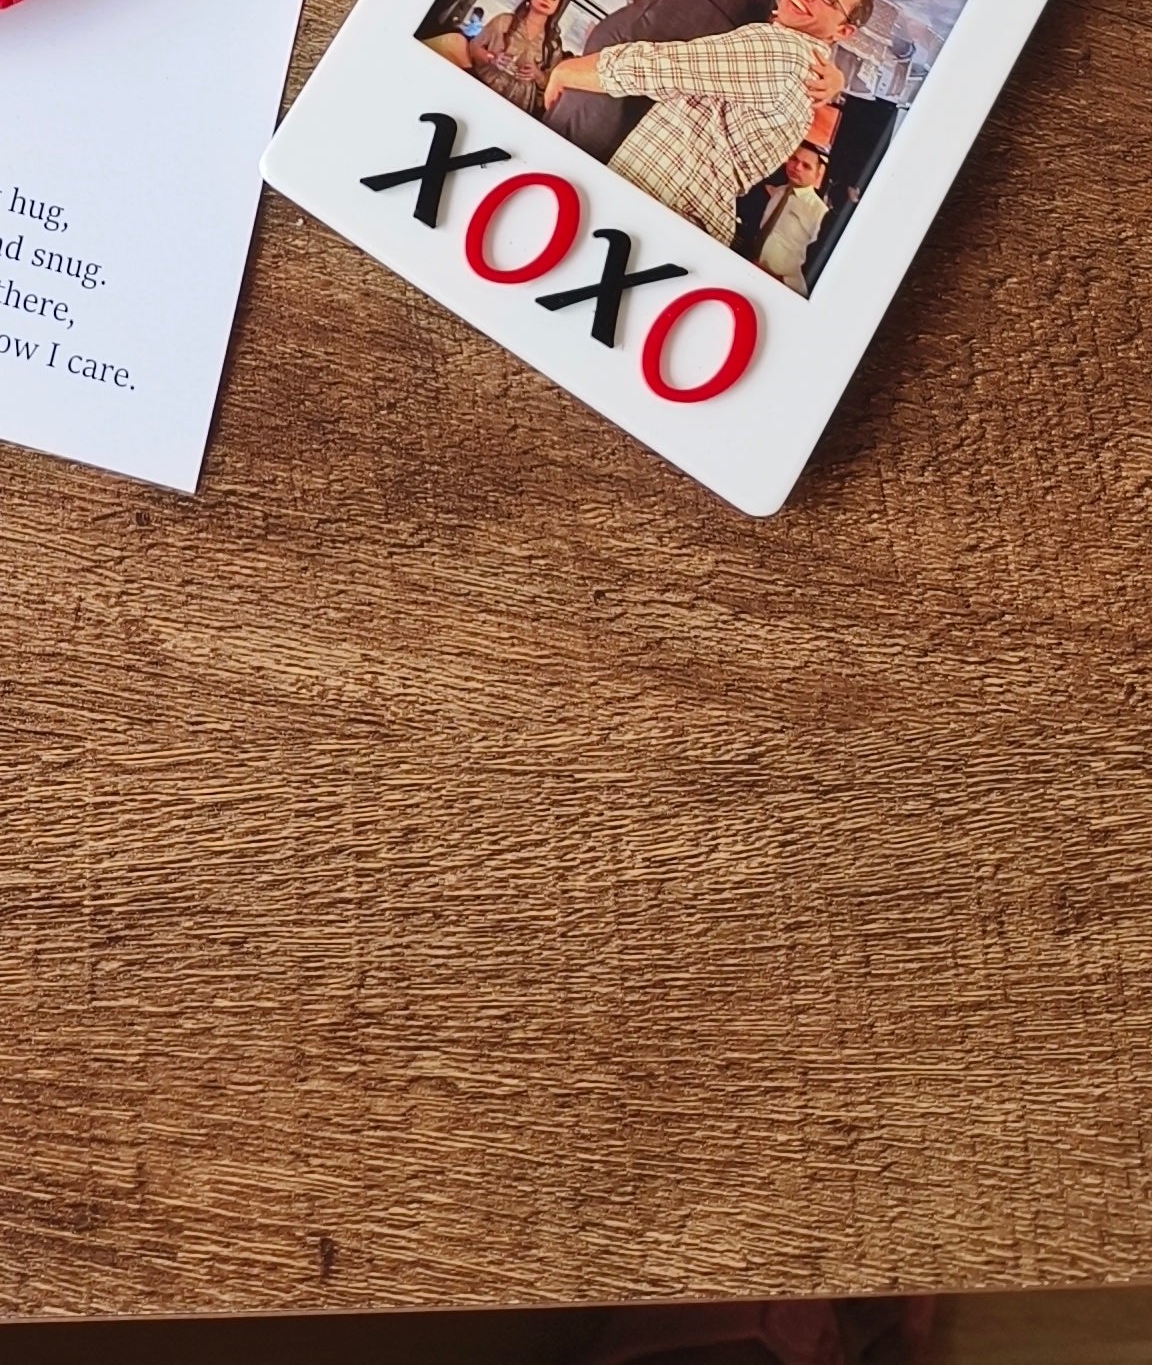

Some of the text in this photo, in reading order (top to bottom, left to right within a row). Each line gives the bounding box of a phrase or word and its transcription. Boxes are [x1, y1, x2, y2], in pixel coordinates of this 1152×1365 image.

[8, 187, 69, 232] hug,
[31, 247, 107, 290] snug.
[360, 112, 758, 403] XOXO
[45, 342, 61, 368] I
[67, 354, 136, 391] care.
